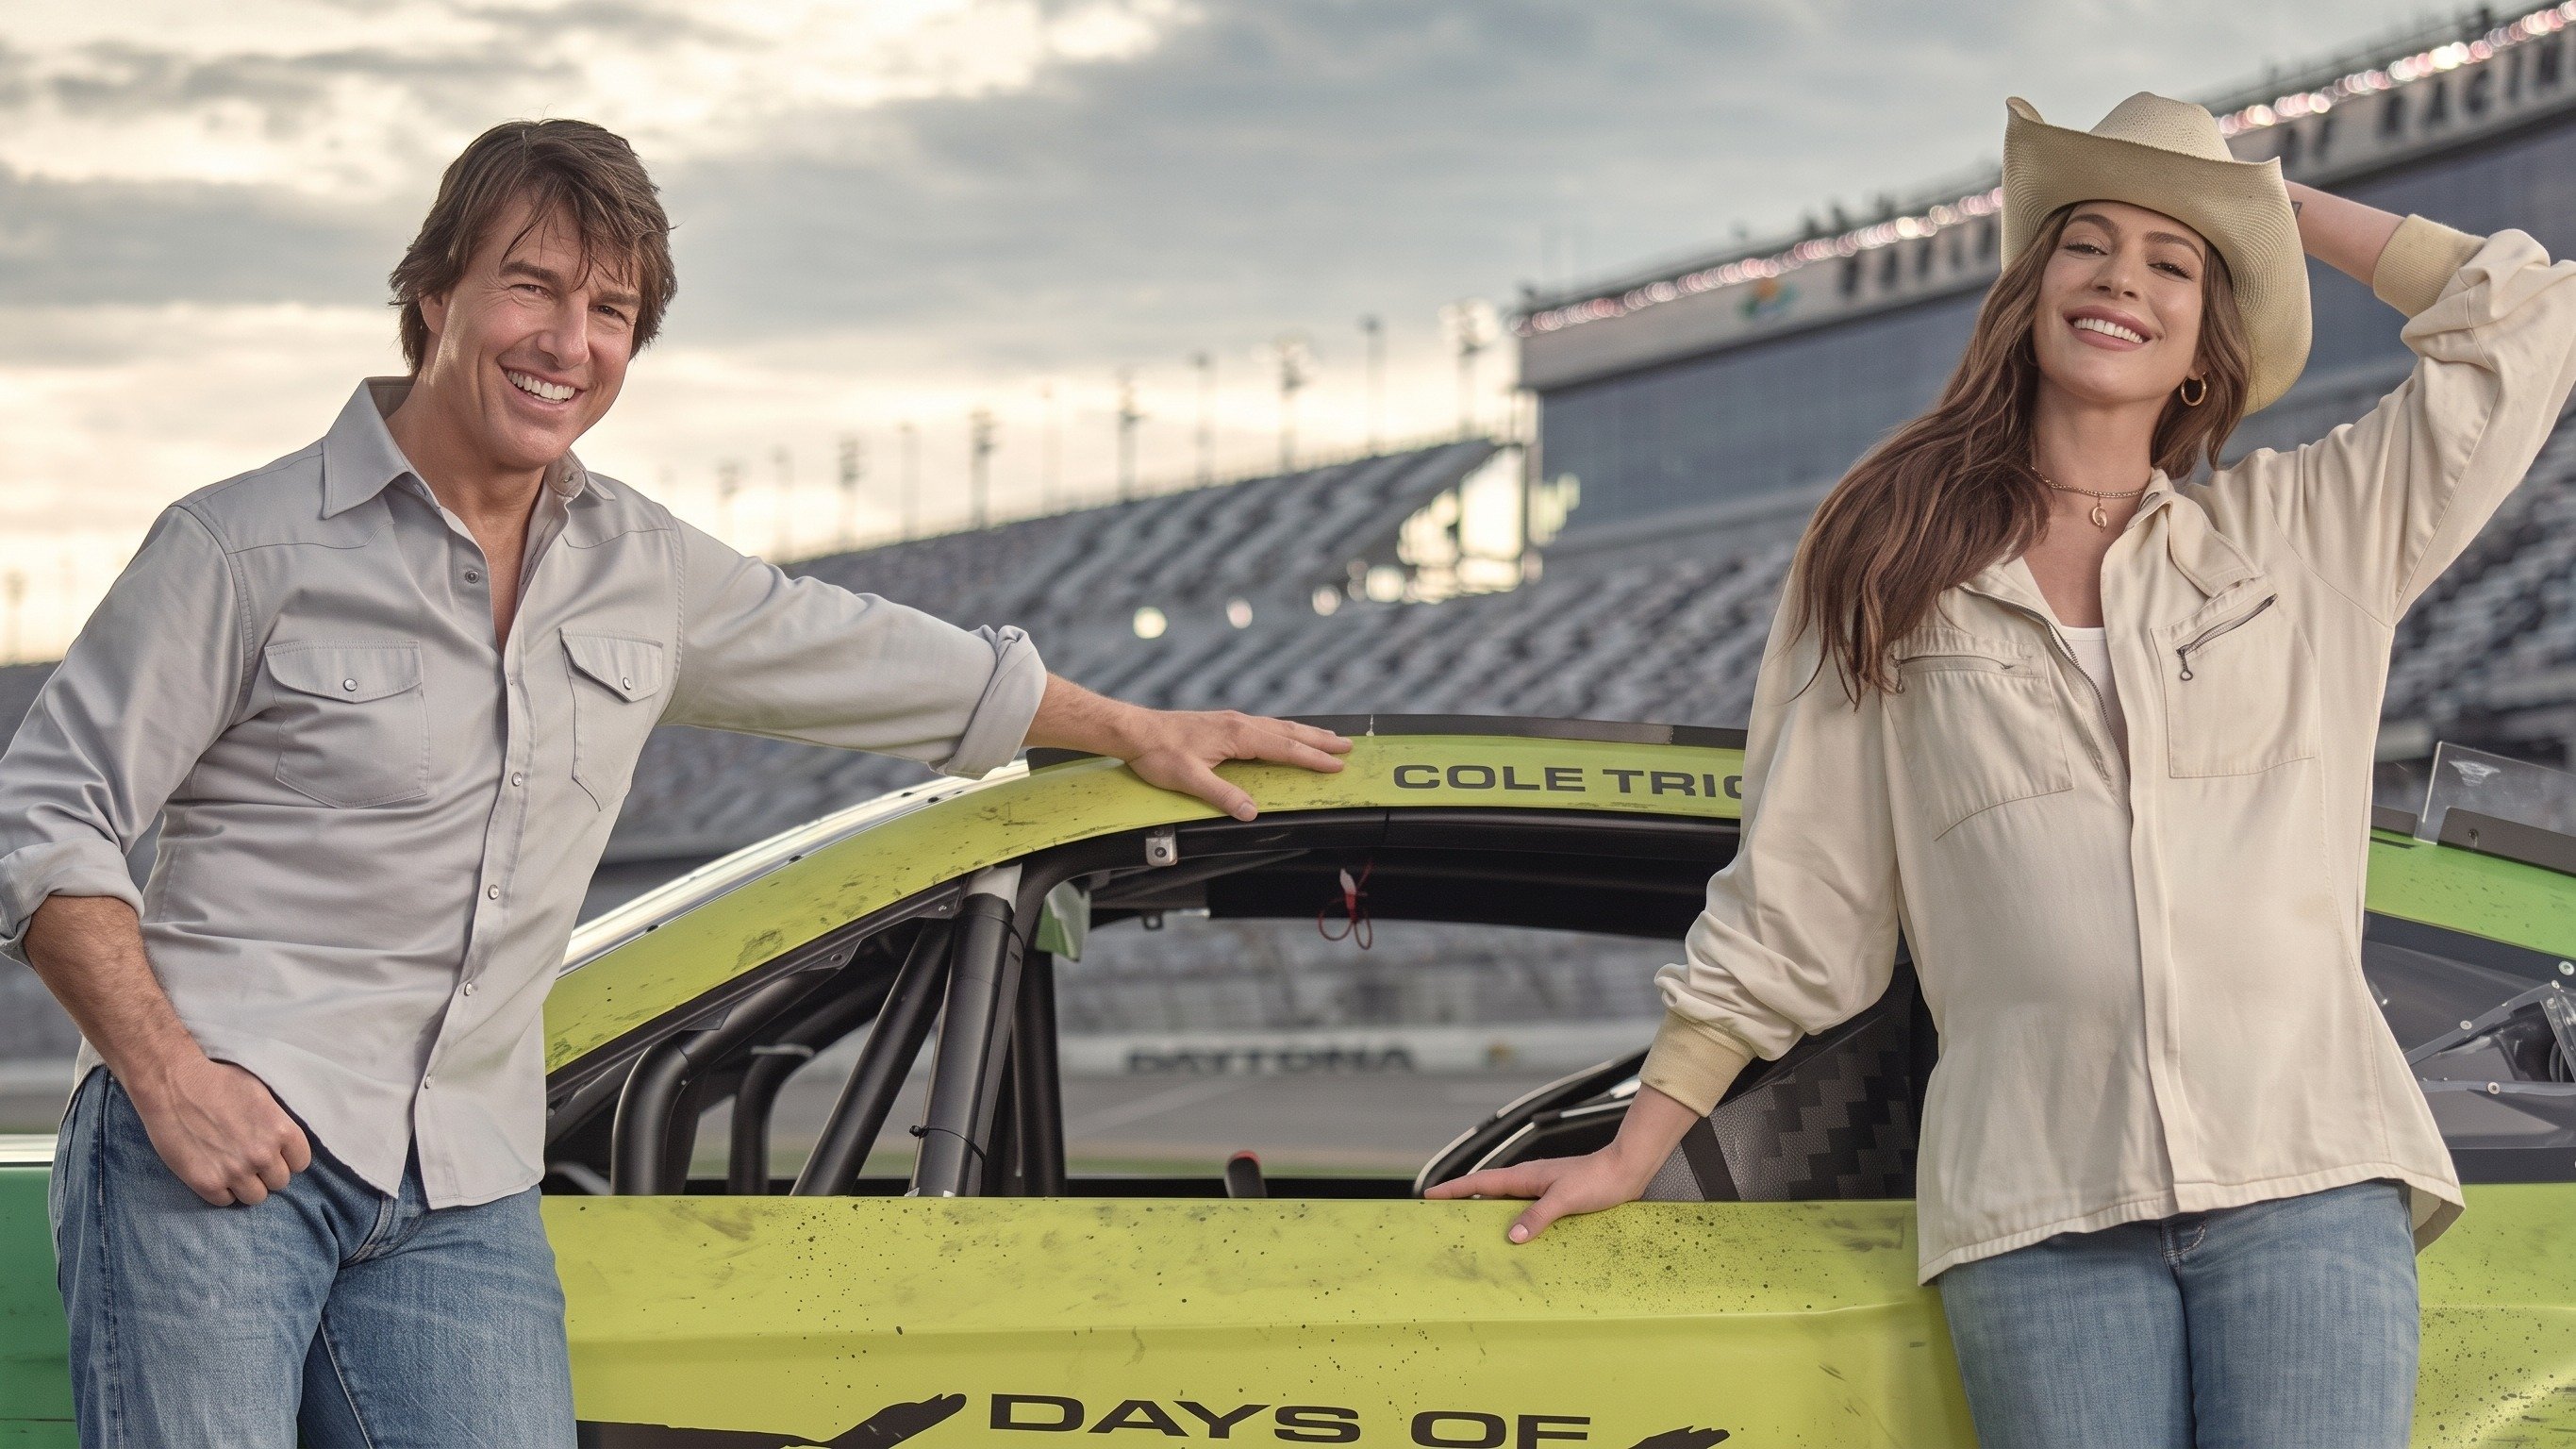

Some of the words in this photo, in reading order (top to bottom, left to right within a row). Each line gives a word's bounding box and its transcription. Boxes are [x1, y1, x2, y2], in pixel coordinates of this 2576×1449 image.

[1393, 764, 1587, 792] COLE
[1125, 1046, 1417, 1075] DAYTONA
[989, 1392, 1361, 1444] DAYS
[1410, 1410, 1591, 1449] OF
